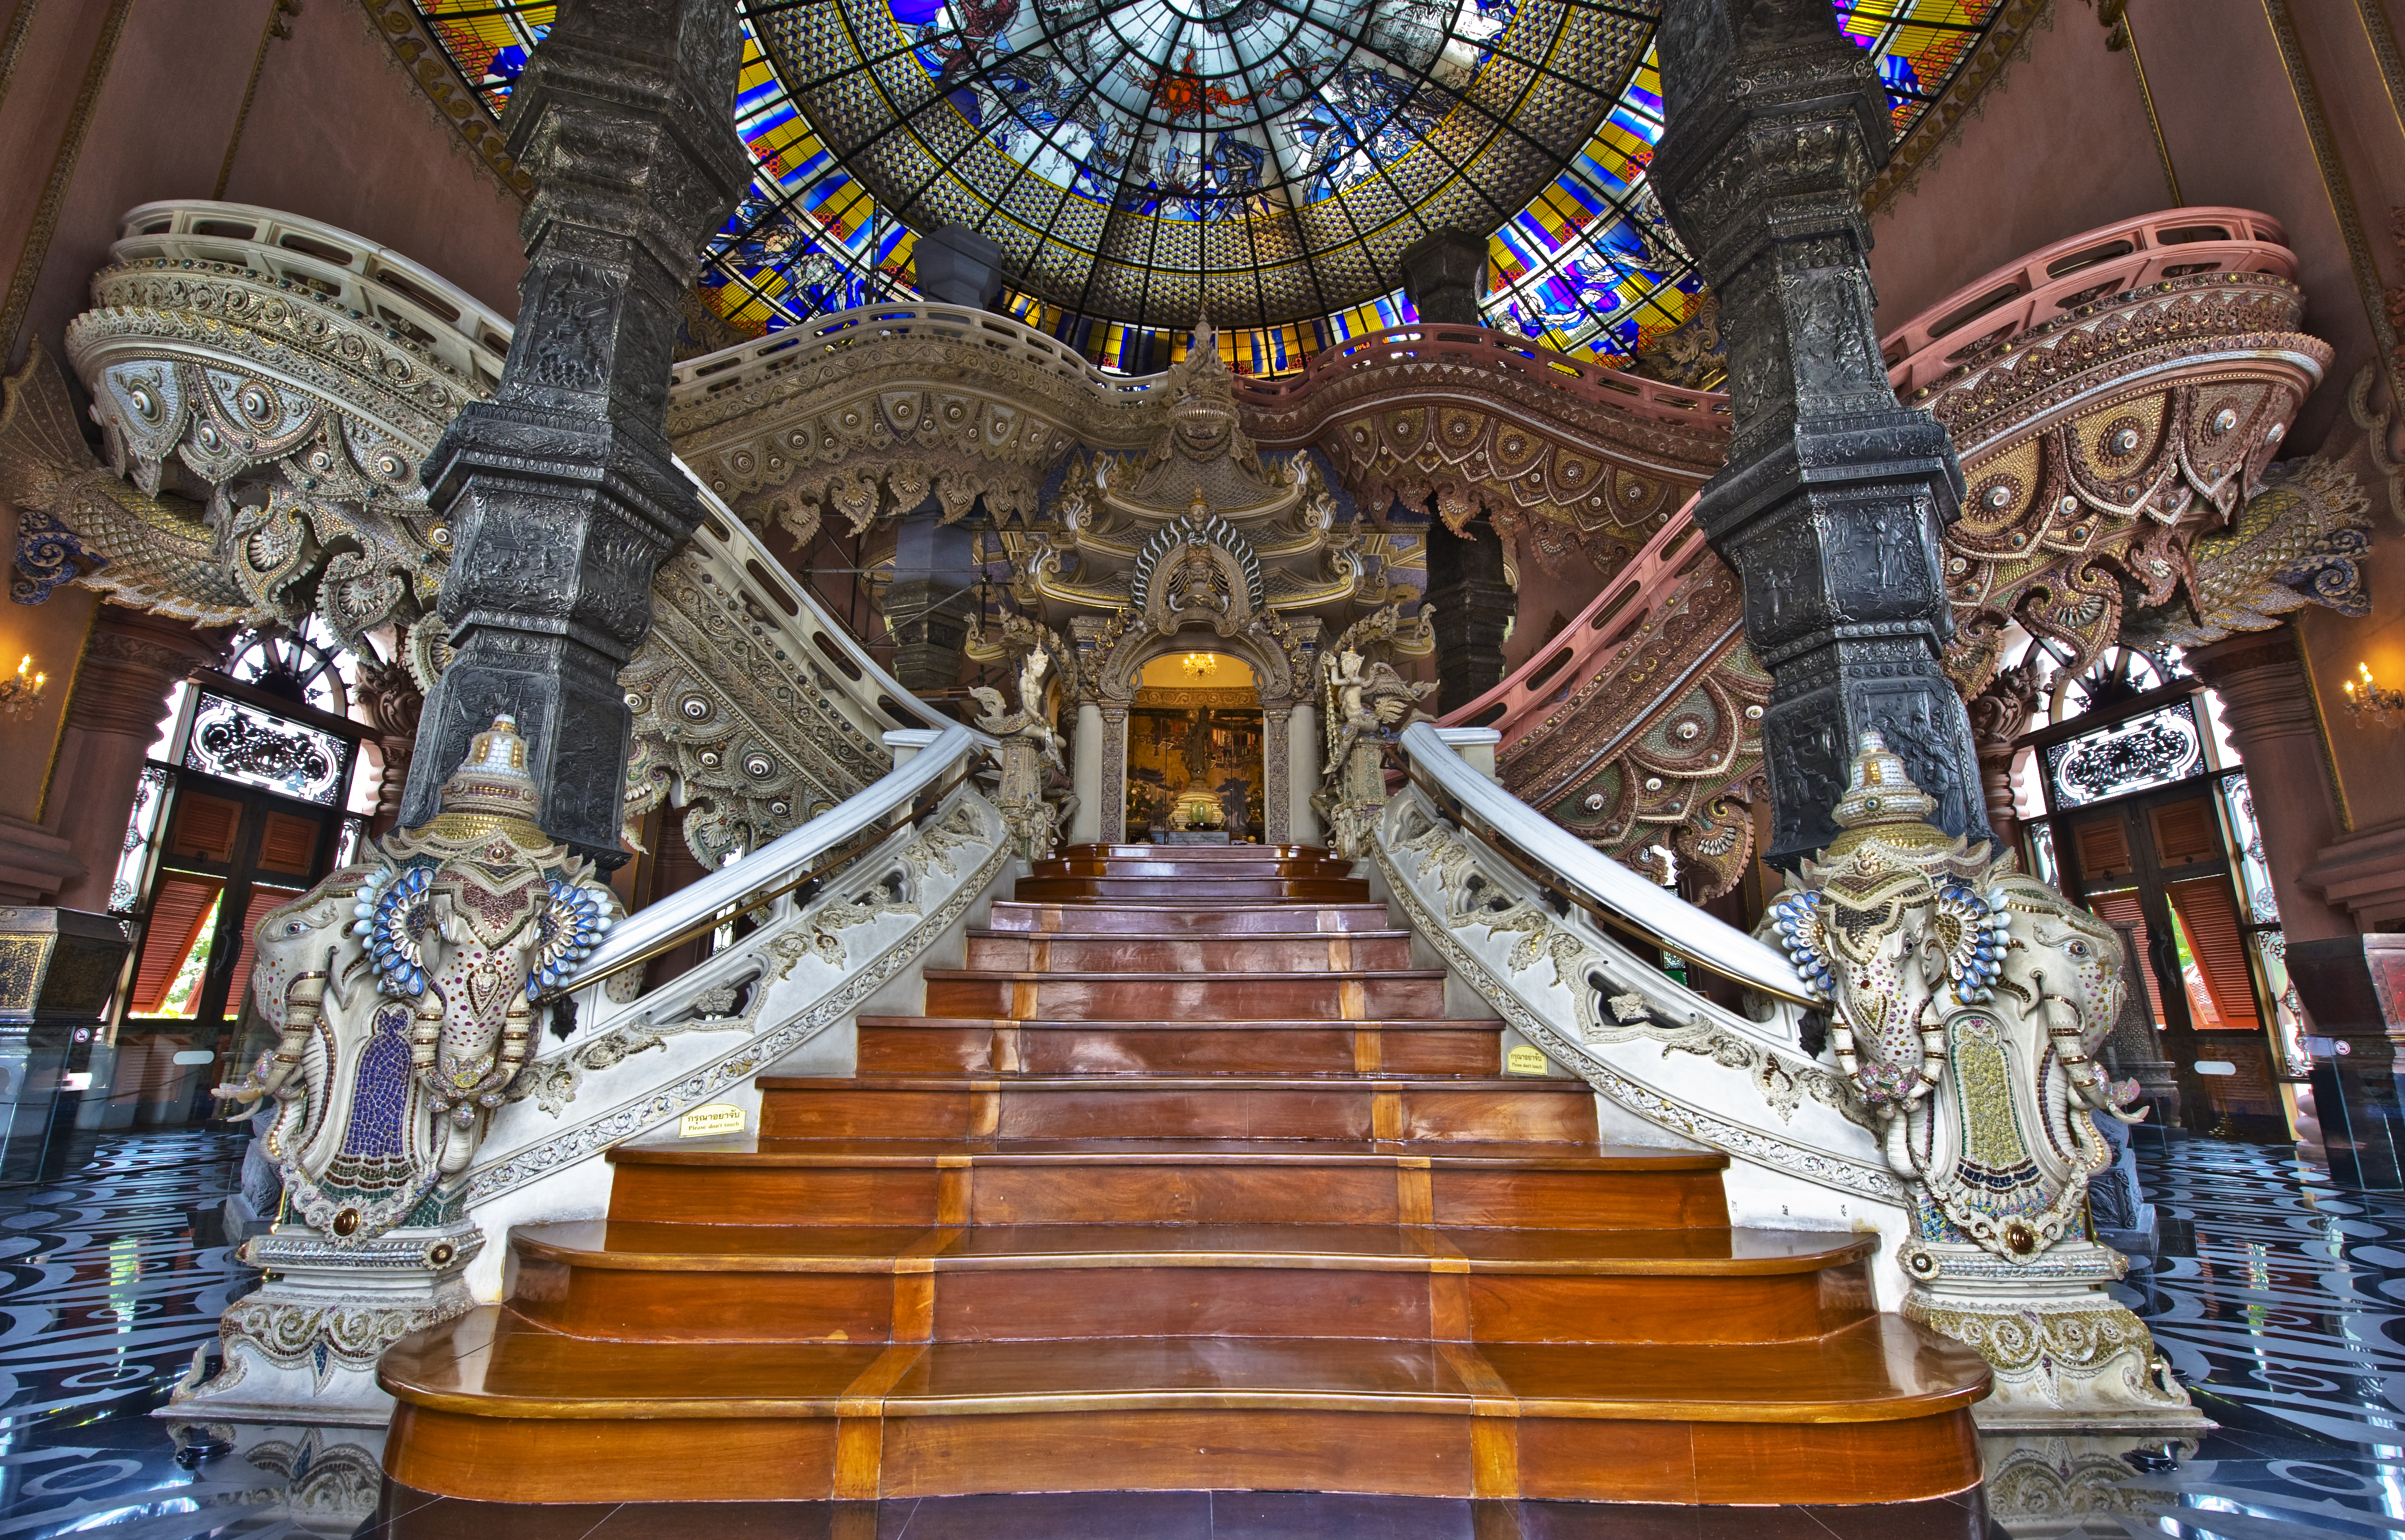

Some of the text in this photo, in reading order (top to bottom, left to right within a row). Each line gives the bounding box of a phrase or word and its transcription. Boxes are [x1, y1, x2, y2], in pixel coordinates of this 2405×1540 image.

[1380, 18, 1396, 47] AUSRALIA
[1511, 1053, 1542, 1062] กรุณาอย่าจับ
[688, 1109, 740, 1125] กรุณาอย่าจับ
